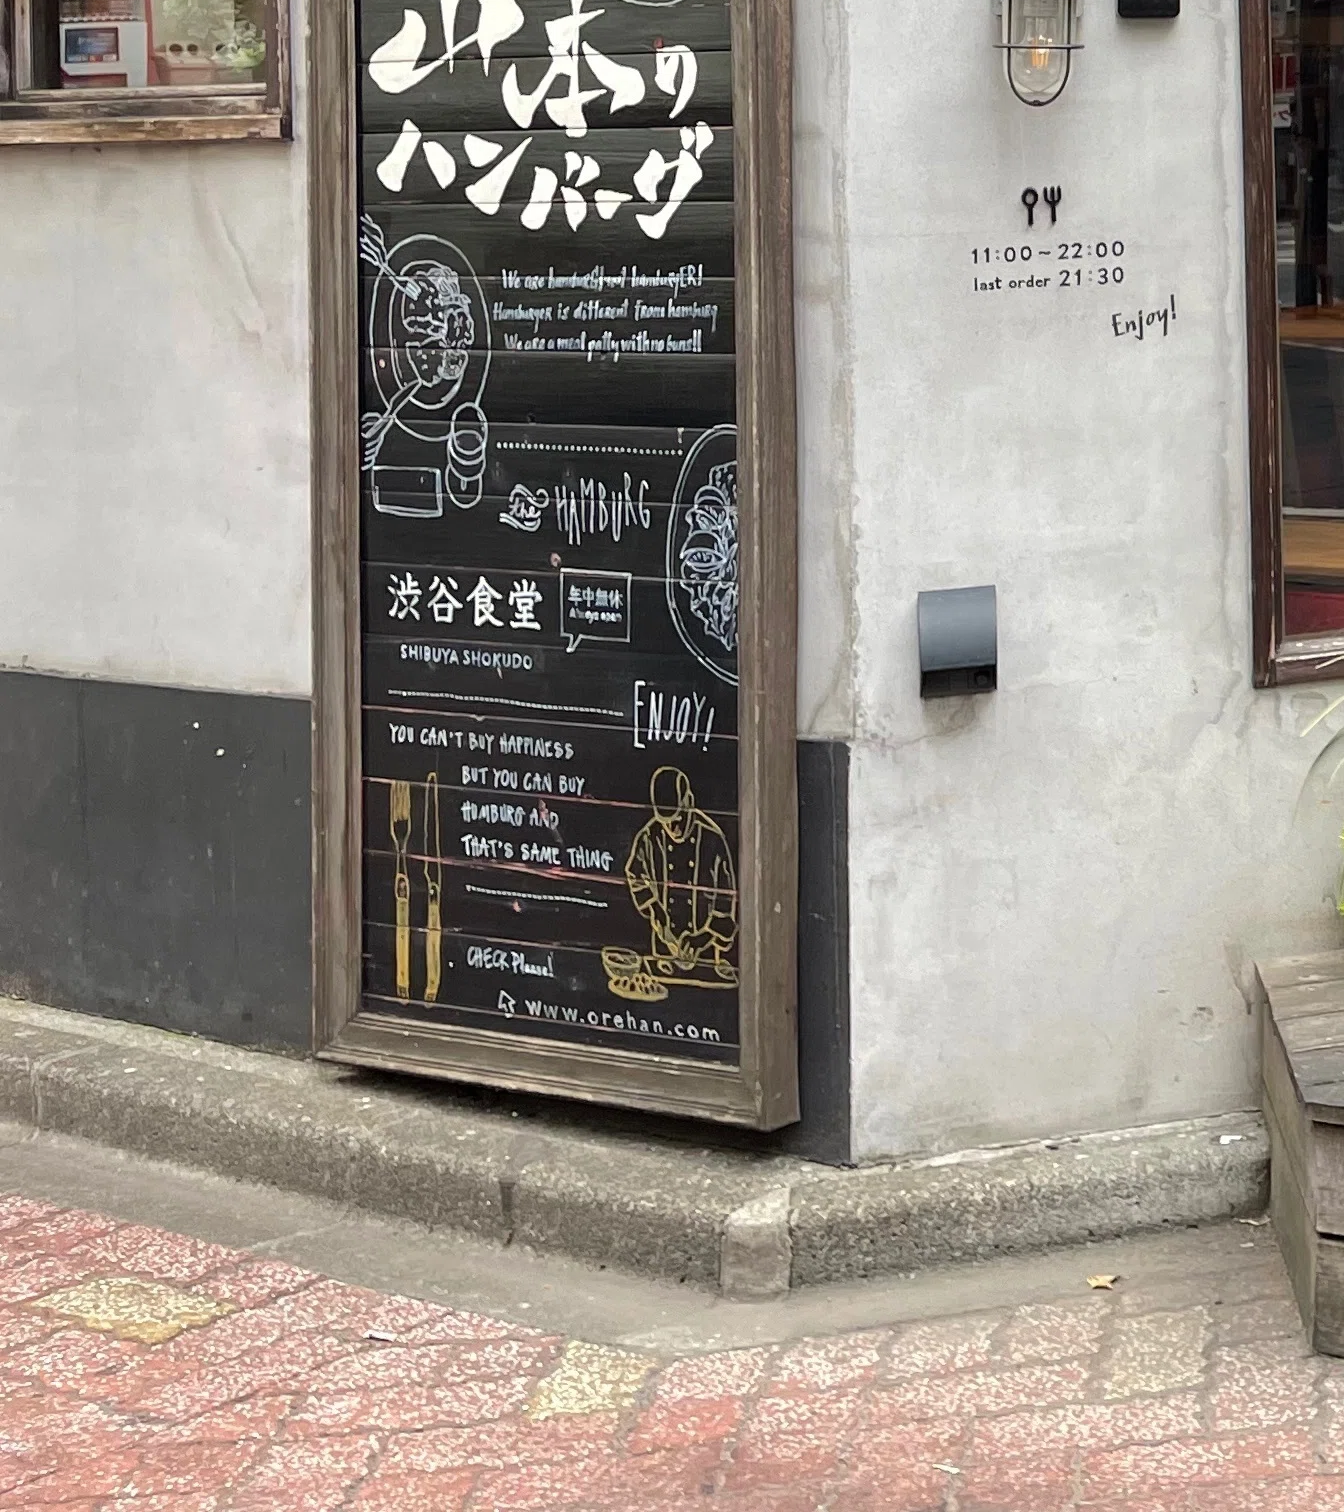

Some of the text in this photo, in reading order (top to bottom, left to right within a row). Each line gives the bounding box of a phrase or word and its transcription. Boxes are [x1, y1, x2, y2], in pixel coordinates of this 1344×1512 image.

[376, 118, 715, 240] ハンバーグ
[502, 267, 521, 289] We
[973, 266, 1125, 292] last order 21:30
[557, 302, 570, 320] is
[1111, 294, 1177, 341] Enjoy!
[504, 332, 523, 351] We
[620, 330, 648, 353] with
[508, 471, 651, 546] the HAMBURG
[387, 571, 544, 631] 渋谷食堂
[567, 584, 624, 610] 年中無休
[400, 643, 534, 671] SHIBUYA SHOKUDO
[633, 680, 715, 753] ENJOY!
[388, 722, 575, 760] YOU CAN'T BUY HAPPINESS
[460, 763, 586, 796] BUT YOU CAN BUY
[529, 807, 560, 830] AND
[460, 834, 614, 872] THAT'S SAME THING
[466, 945, 510, 971] CHECK
[524, 999, 722, 1043] www.orehan.com
